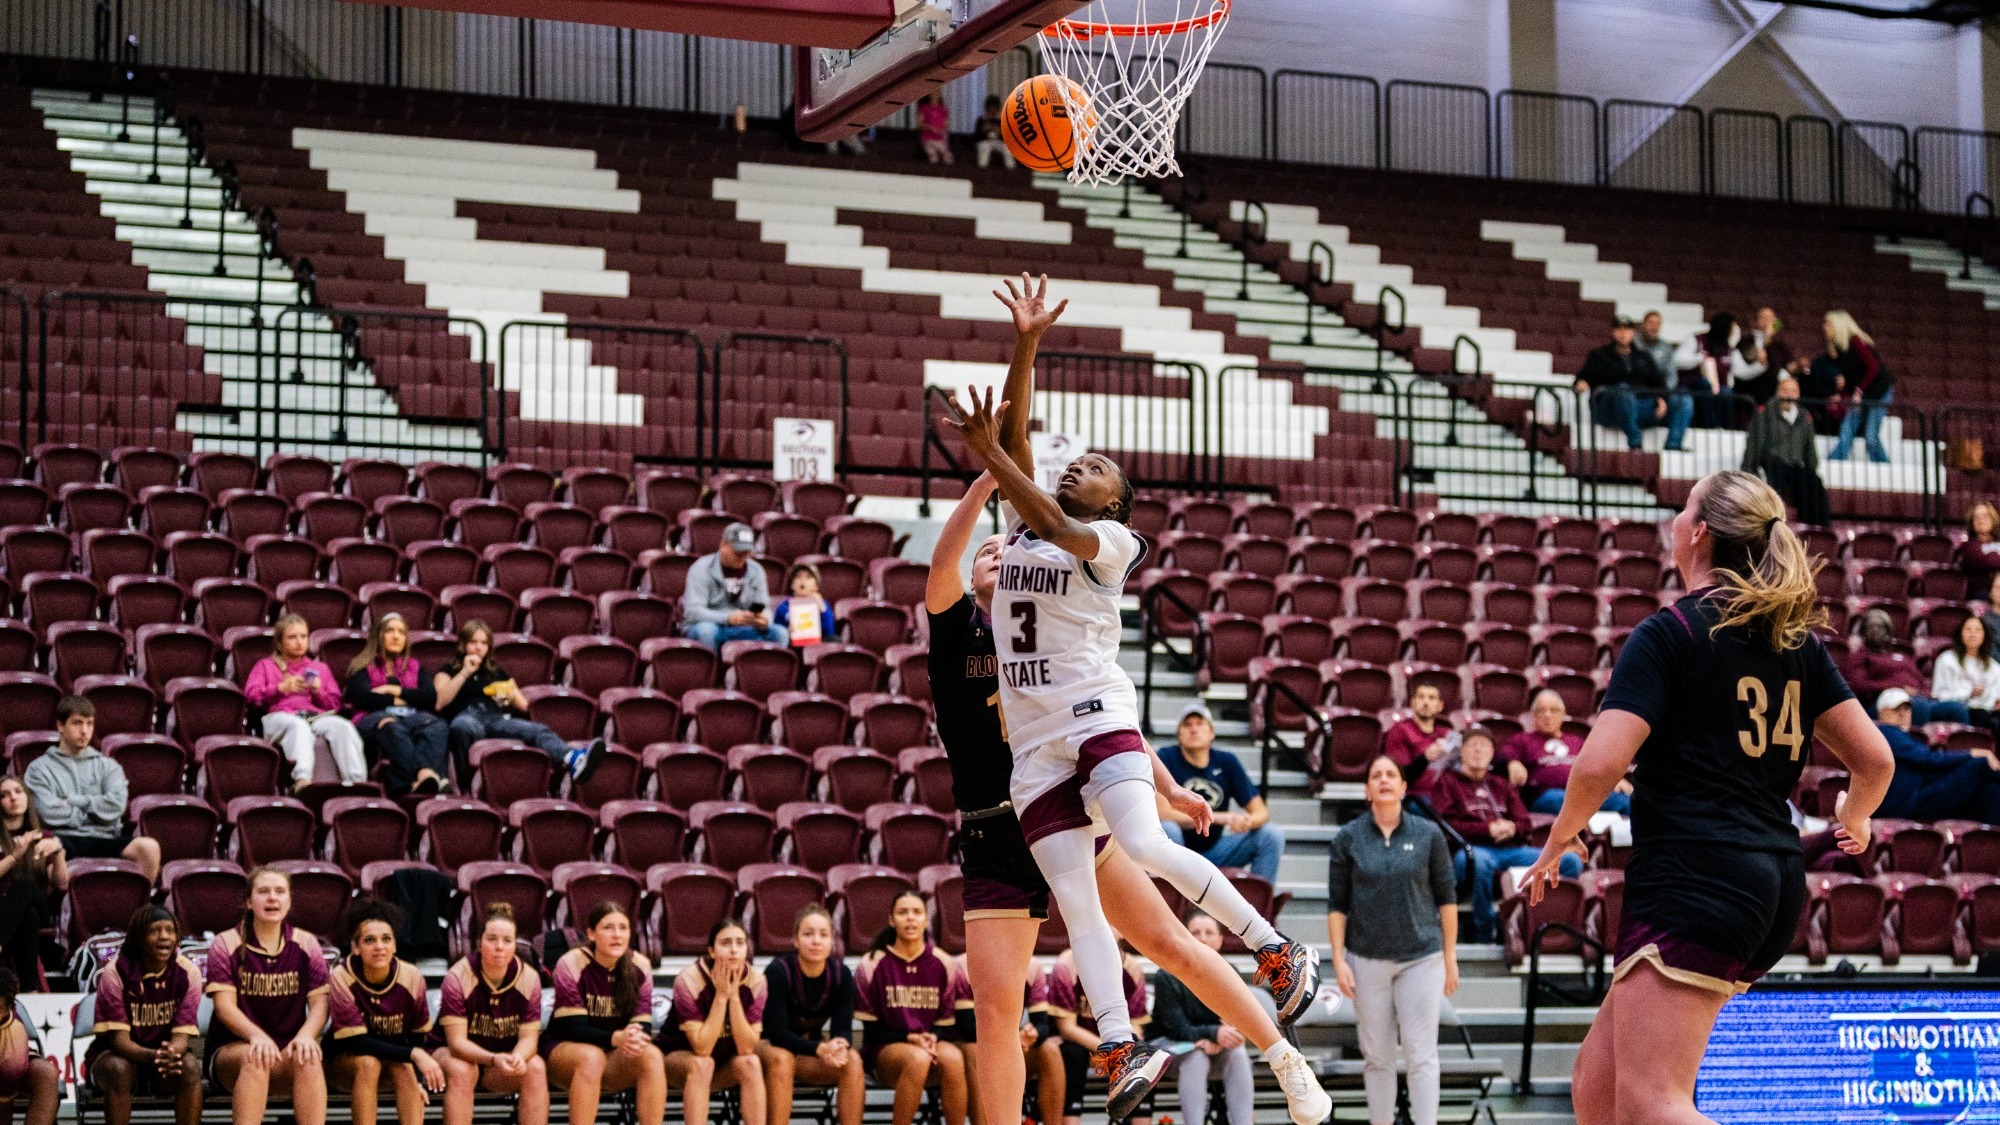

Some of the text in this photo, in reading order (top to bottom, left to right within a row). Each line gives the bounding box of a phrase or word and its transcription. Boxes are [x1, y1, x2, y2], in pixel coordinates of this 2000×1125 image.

[790, 457, 818, 480] 103
[998, 564, 1073, 597] AIRMONT
[1010, 601, 1038, 654] 3
[1002, 659, 1052, 688] STATE
[1736, 675, 1805, 762] 34
[240, 971, 299, 997] BLOOMSBURG
[1914, 1051, 1935, 1077] &
